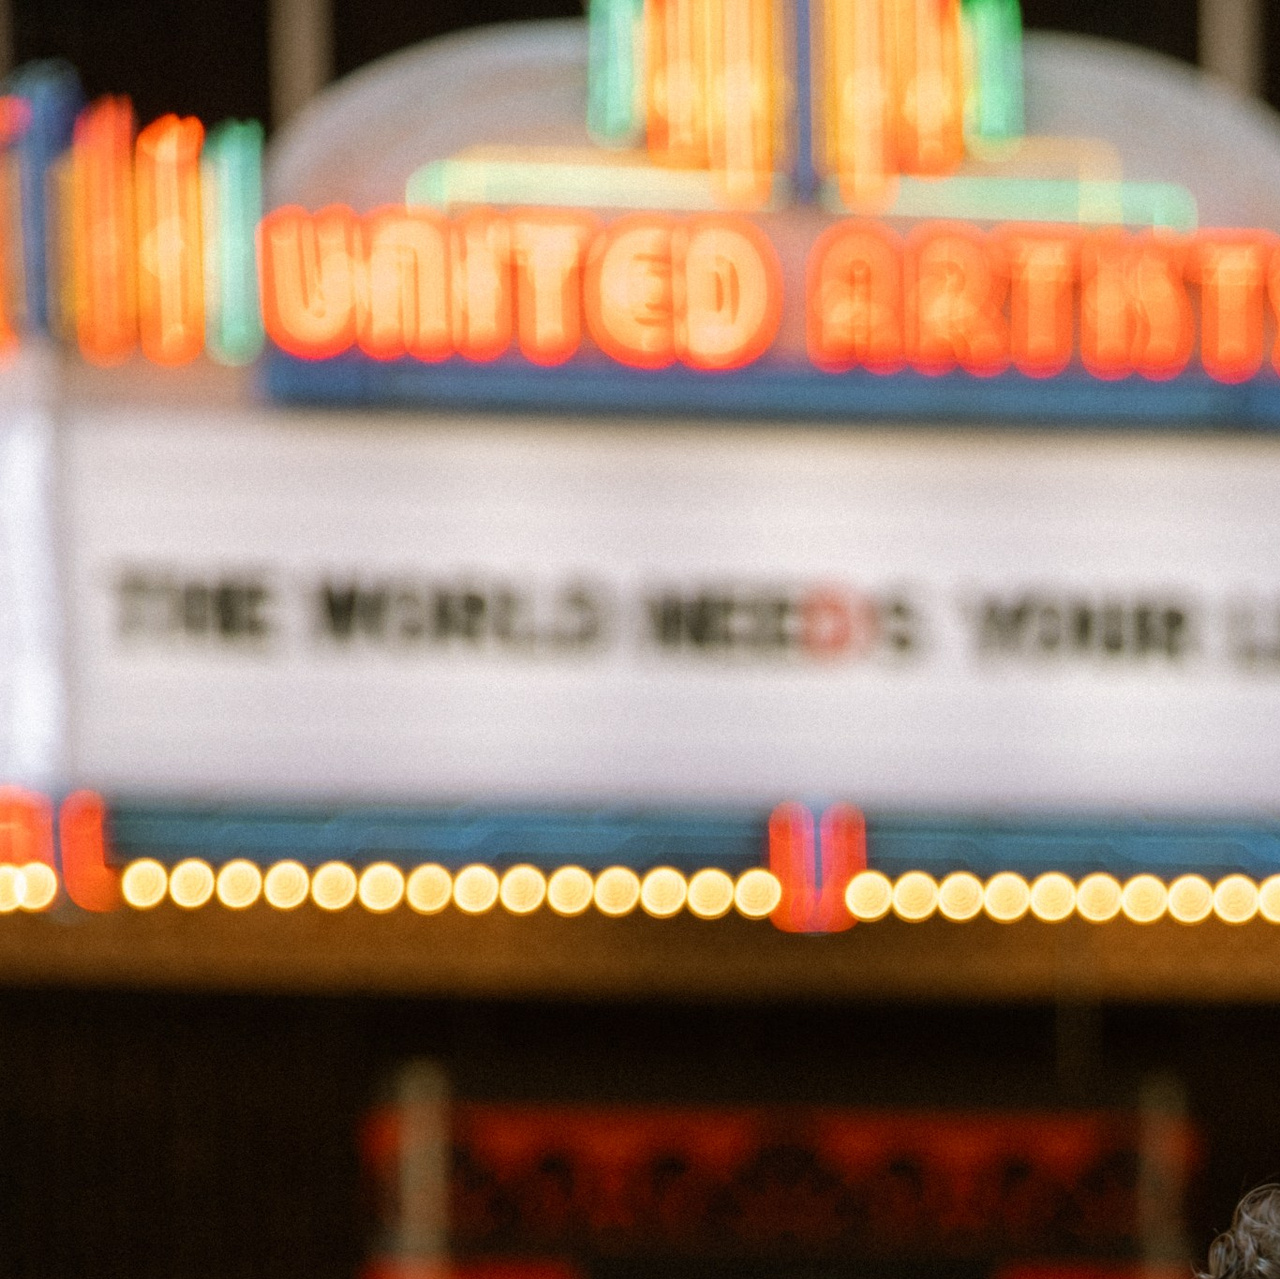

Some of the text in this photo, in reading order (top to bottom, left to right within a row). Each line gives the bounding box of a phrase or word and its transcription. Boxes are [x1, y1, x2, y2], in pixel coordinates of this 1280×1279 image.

[259, 205, 783, 370] UNITED
[113, 563, 272, 648] THE
[315, 566, 602, 650] WORLD
[968, 585, 1190, 670] YOUR
